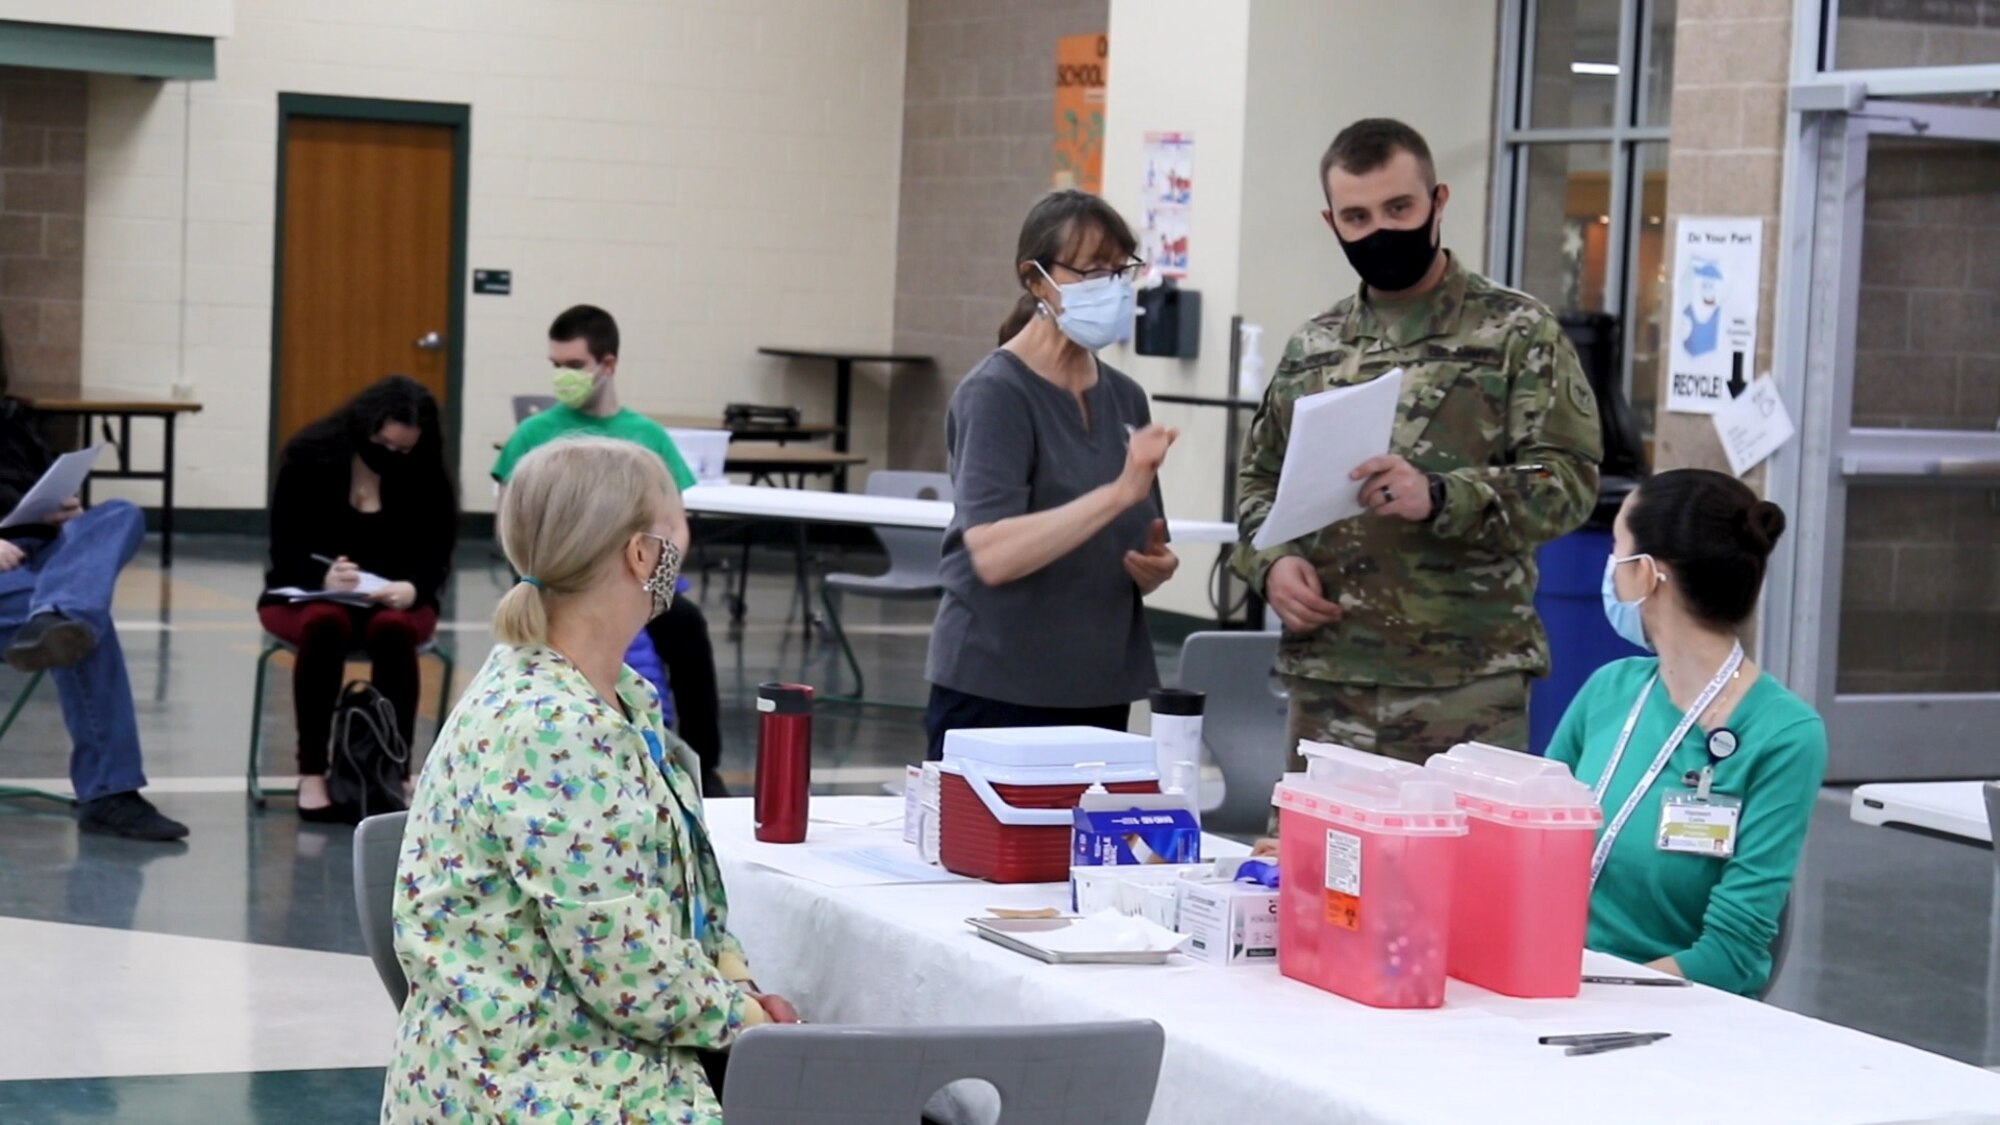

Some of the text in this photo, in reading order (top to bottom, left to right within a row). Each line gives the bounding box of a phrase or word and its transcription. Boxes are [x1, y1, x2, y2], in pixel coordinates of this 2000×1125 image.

[1056, 65, 1105, 87] SCHOOL
[1688, 233, 1752, 243] Do Your Part
[1673, 374, 1723, 398] RECYCLE!
